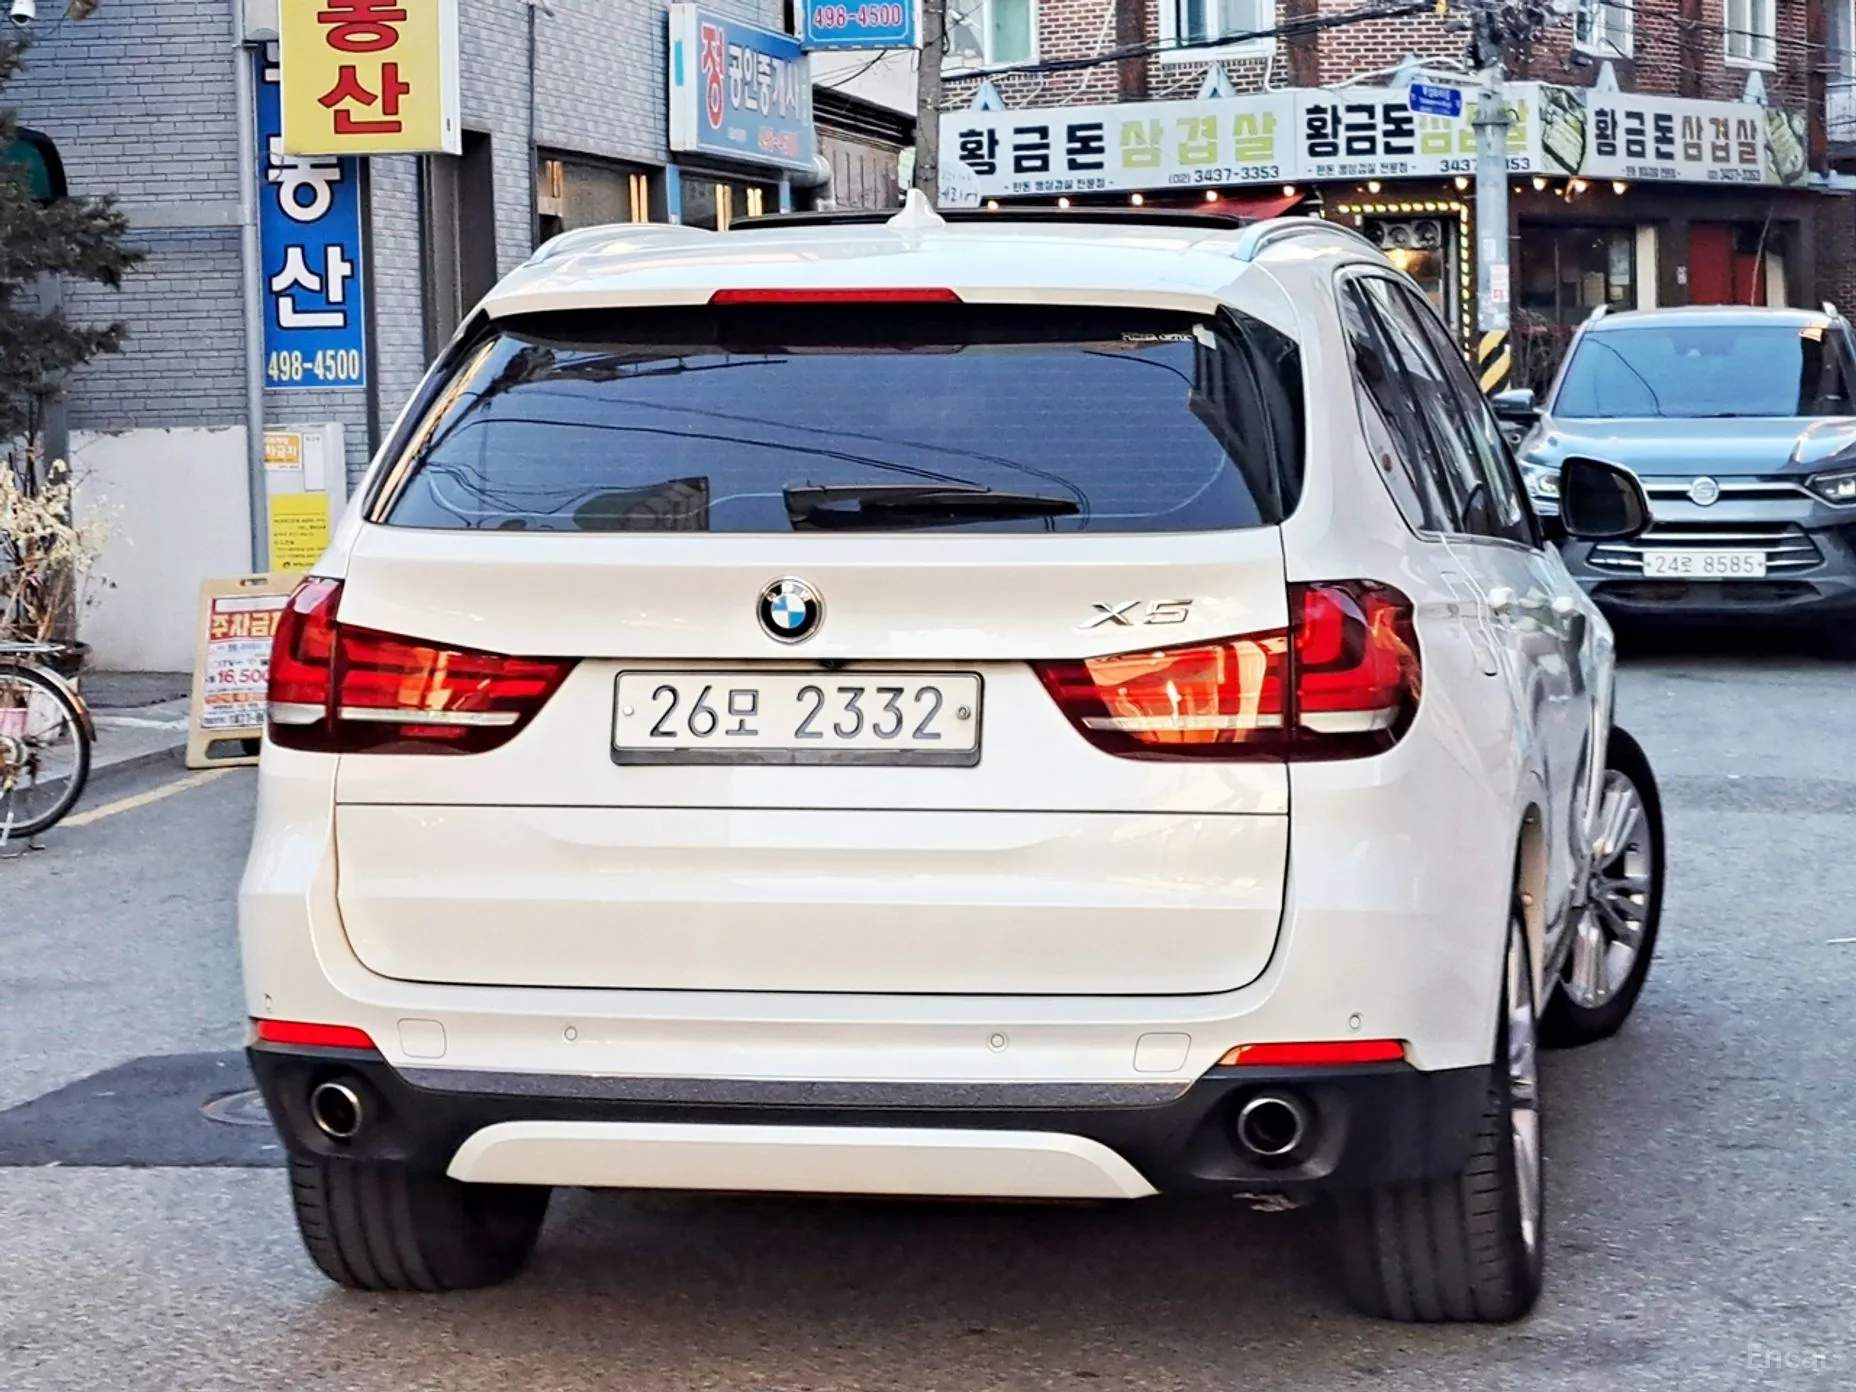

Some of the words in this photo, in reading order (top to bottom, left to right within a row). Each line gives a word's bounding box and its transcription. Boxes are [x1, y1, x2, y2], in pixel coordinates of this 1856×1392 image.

[812, 5, 903, 28] 498-4500
[701, 22, 724, 129] 정
[1194, 165, 1279, 183] 3437-3353
[267, 350, 360, 381] 498-4500
[1703, 555, 1755, 574] 8585
[1078, 599, 1193, 629] X5
[649, 685, 759, 738] 26모
[794, 685, 944, 739] 2332
